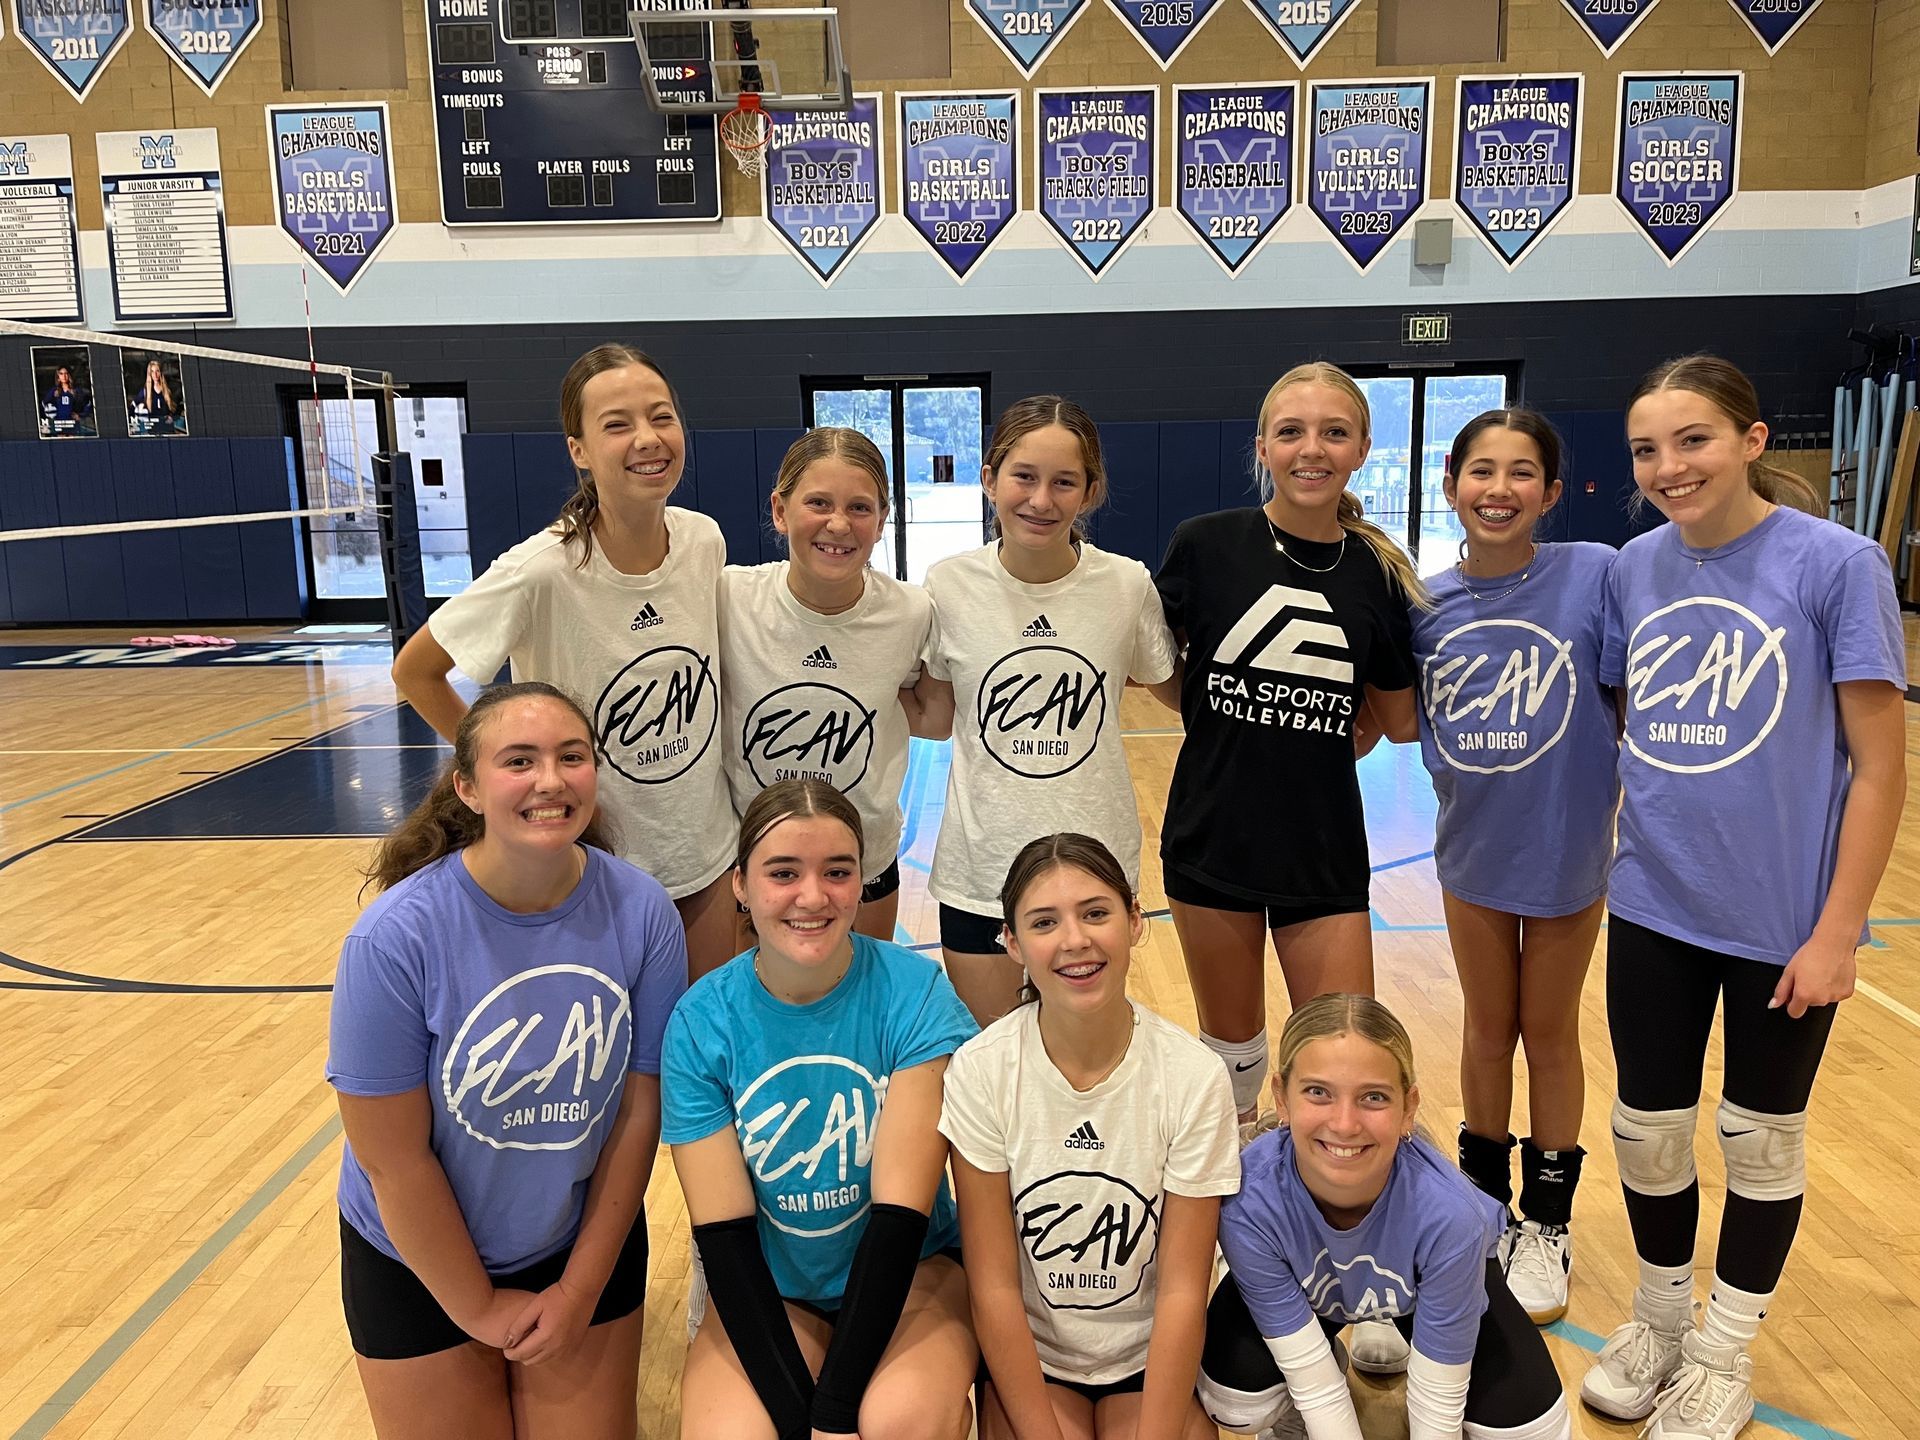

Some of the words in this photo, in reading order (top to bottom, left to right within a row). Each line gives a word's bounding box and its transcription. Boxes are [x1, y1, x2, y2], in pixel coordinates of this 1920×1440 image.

[439, 0, 489, 17] HOME
[640, 0, 705, 11] VISITOR
[1140, 2, 1194, 27] 2015
[1278, 1, 1332, 25] 2015
[1002, 11, 1053, 34] 2014
[51, 36, 100, 61] 2011
[180, 30, 232, 54] 2012
[546, 46, 571, 58] POSS
[462, 69, 503, 83] BONUS
[537, 58, 583, 73] PERIOD
[652, 66, 683, 80] ONUS
[442, 94, 504, 108] TIMEOUTS
[1344, 92, 1398, 108] LEAGUE
[1493, 87, 1548, 102] LEAGUE
[1654, 84, 1710, 99] LEAGUE
[932, 103, 986, 118] LEAGUE
[1071, 100, 1124, 115] LEAGUE
[1210, 96, 1263, 111] LEAGUE
[1628, 98, 1731, 127] CHAMPIONS
[302, 115, 356, 130] LEAGUE
[795, 111, 847, 122] LEAGUE
[1185, 111, 1286, 140] CHAMPIONS
[1318, 106, 1421, 137] CHAMPIONS
[1467, 101, 1570, 131] CHAMPIONS
[771, 121, 871, 150] CHAMPIONS
[909, 117, 1010, 147] CHAMPIONS
[1046, 114, 1147, 142] CHAMPIONS
[280, 131, 381, 159] CHAMPIONS
[461, 142, 491, 155] LEFT
[663, 138, 692, 151] LEFT
[1483, 143, 1547, 163] BOYS
[1646, 139, 1709, 158] GIRLS
[537, 160, 583, 174] PLAYER
[592, 159, 631, 173] FOULS
[656, 158, 694, 172] FOULS
[927, 158, 991, 177] GIRLS
[1065, 155, 1128, 174] BOYS
[1336, 147, 1399, 166] GIRLS
[302, 170, 364, 189] GIRLS
[463, 162, 501, 176] FOULS
[790, 162, 853, 181] BOYS
[1184, 162, 1285, 189] BASEBALL
[1317, 168, 1417, 192] VOLLEYBALL
[1463, 164, 1567, 189] BASKETBALL
[1629, 159, 1723, 183] SOCCER
[3, 186, 52, 196] VOLLEYBALL
[127, 182, 158, 191] JUNIOR
[160, 180, 195, 190] VARSITY
[773, 182, 874, 207] BASKETBALL
[910, 179, 1010, 202] BASKETBALL
[1046, 177, 1094, 199] TRACK
[1096, 176, 1106, 198] &
[1109, 175, 1147, 198] FIELD
[285, 190, 386, 215] BASKETBALL
[1647, 202, 1702, 226] 2023
[1072, 219, 1122, 242] 2022
[1209, 215, 1259, 238] 2022
[1340, 211, 1394, 235] 2023
[1487, 208, 1541, 231] 2023
[800, 225, 850, 248] 2021
[934, 220, 987, 244] 2022
[314, 233, 366, 256] 2021
[1416, 320, 1442, 338] EXIT
[630, 614, 664, 632] adidas
[1022, 628, 1057, 637] adidas
[801, 657, 838, 670] adidas
[1207, 672, 1249, 699] FCA
[1256, 682, 1352, 716] SPORTS
[1427, 639, 1573, 727] FCAV
[599, 654, 711, 750] FCAV
[979, 670, 1107, 739] FCAV
[1209, 694, 1347, 737] VOLLEYBALL
[743, 708, 877, 768] FCAV
[1458, 733, 1484, 750] SAN
[1487, 731, 1528, 750] DIEGO
[1649, 722, 1677, 743] SAN
[1681, 723, 1727, 746] DIEGO
[637, 749, 660, 766] SAN
[663, 736, 689, 760] DIEGO
[1012, 740, 1033, 755] SAN
[1037, 740, 1069, 756] DIEGO
[775, 768, 798, 782] SAN
[801, 771, 833, 785] DIEGO
[448, 988, 630, 1112] FCAV
[502, 1107, 535, 1130] SAN
[540, 1100, 589, 1123] DIEGO
[1064, 1138, 1105, 1150] adidas
[777, 1194, 808, 1213] SAN
[813, 1184, 860, 1211] DIEGO
[1020, 1194, 1158, 1271] FCAV
[1048, 1272, 1074, 1289] SAN
[1079, 1274, 1117, 1290] DIEGO
